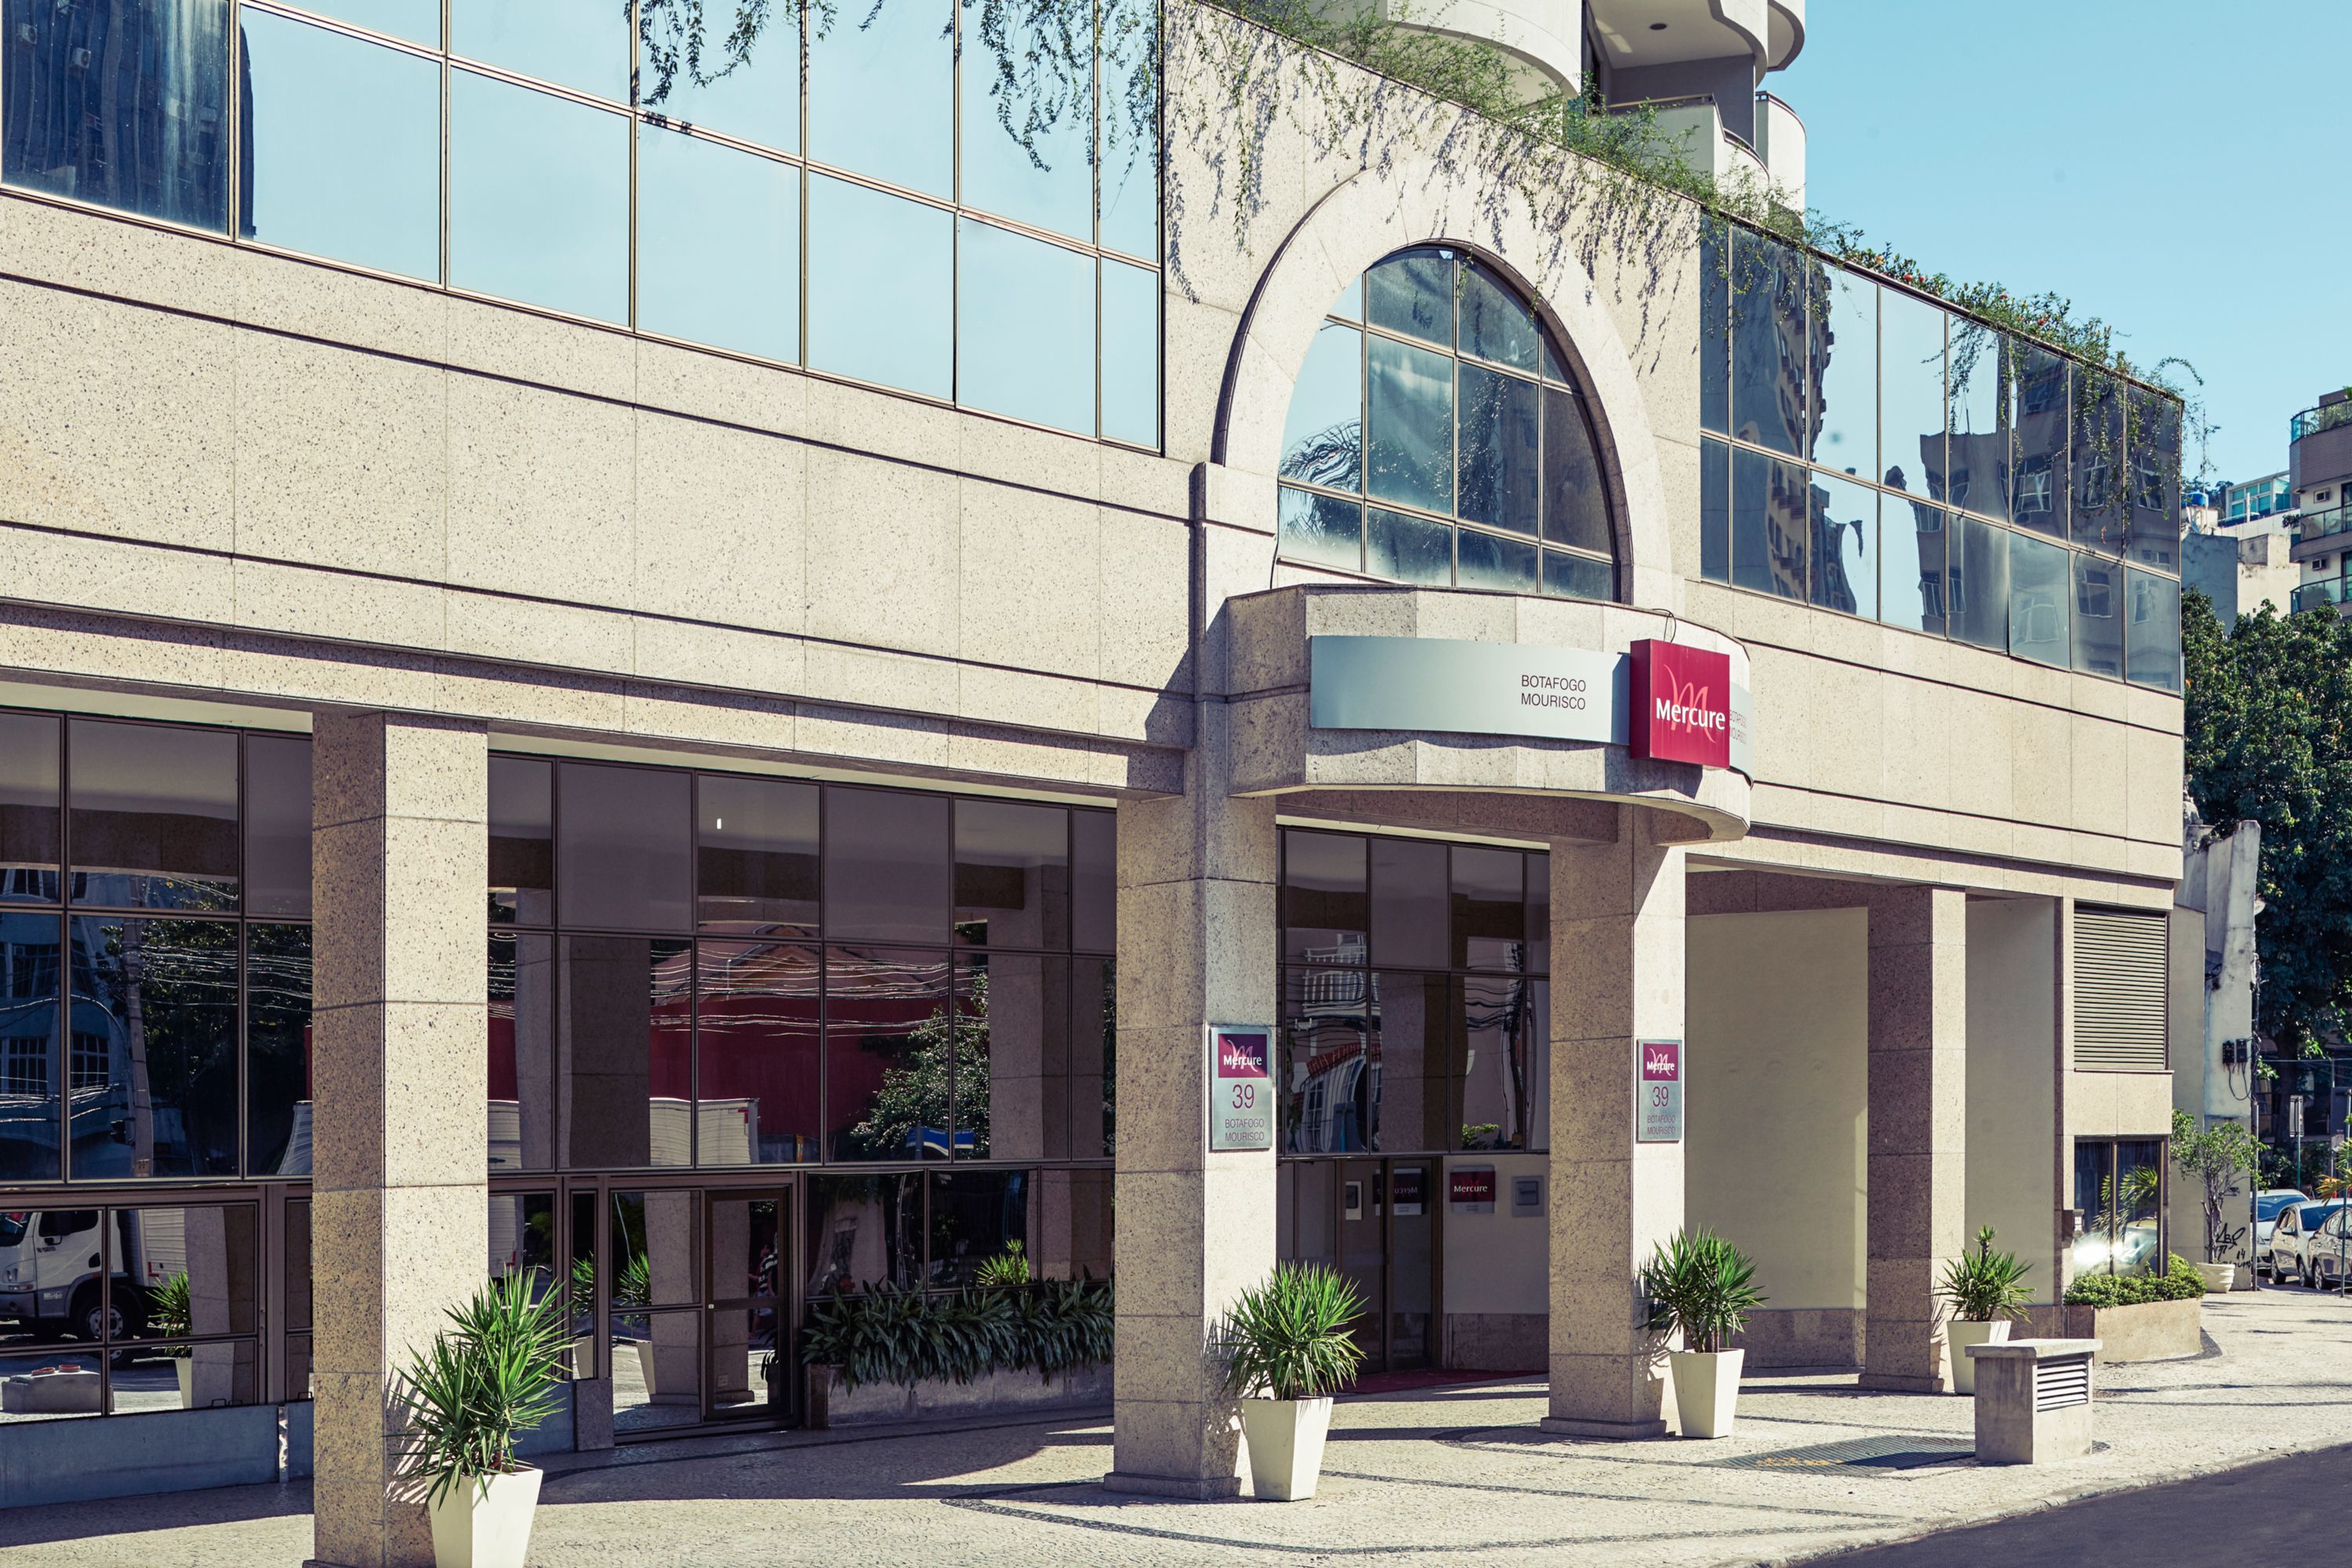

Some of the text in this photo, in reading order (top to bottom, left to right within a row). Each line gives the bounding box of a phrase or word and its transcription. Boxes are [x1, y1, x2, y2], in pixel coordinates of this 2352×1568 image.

[1521, 674, 1586, 692] BOTAFOGO
[1521, 692, 1586, 710] MOURISCO
[1656, 697, 1726, 731] Mercure
[1223, 1054, 1262, 1066] Mercure
[1646, 1061, 1675, 1071] Mercure
[1232, 1083, 1254, 1109] 39
[1653, 1086, 1669, 1107] 39
[1225, 1118, 1265, 1129] BOTAFOGO
[1225, 1131, 1265, 1142] MOURISCO
